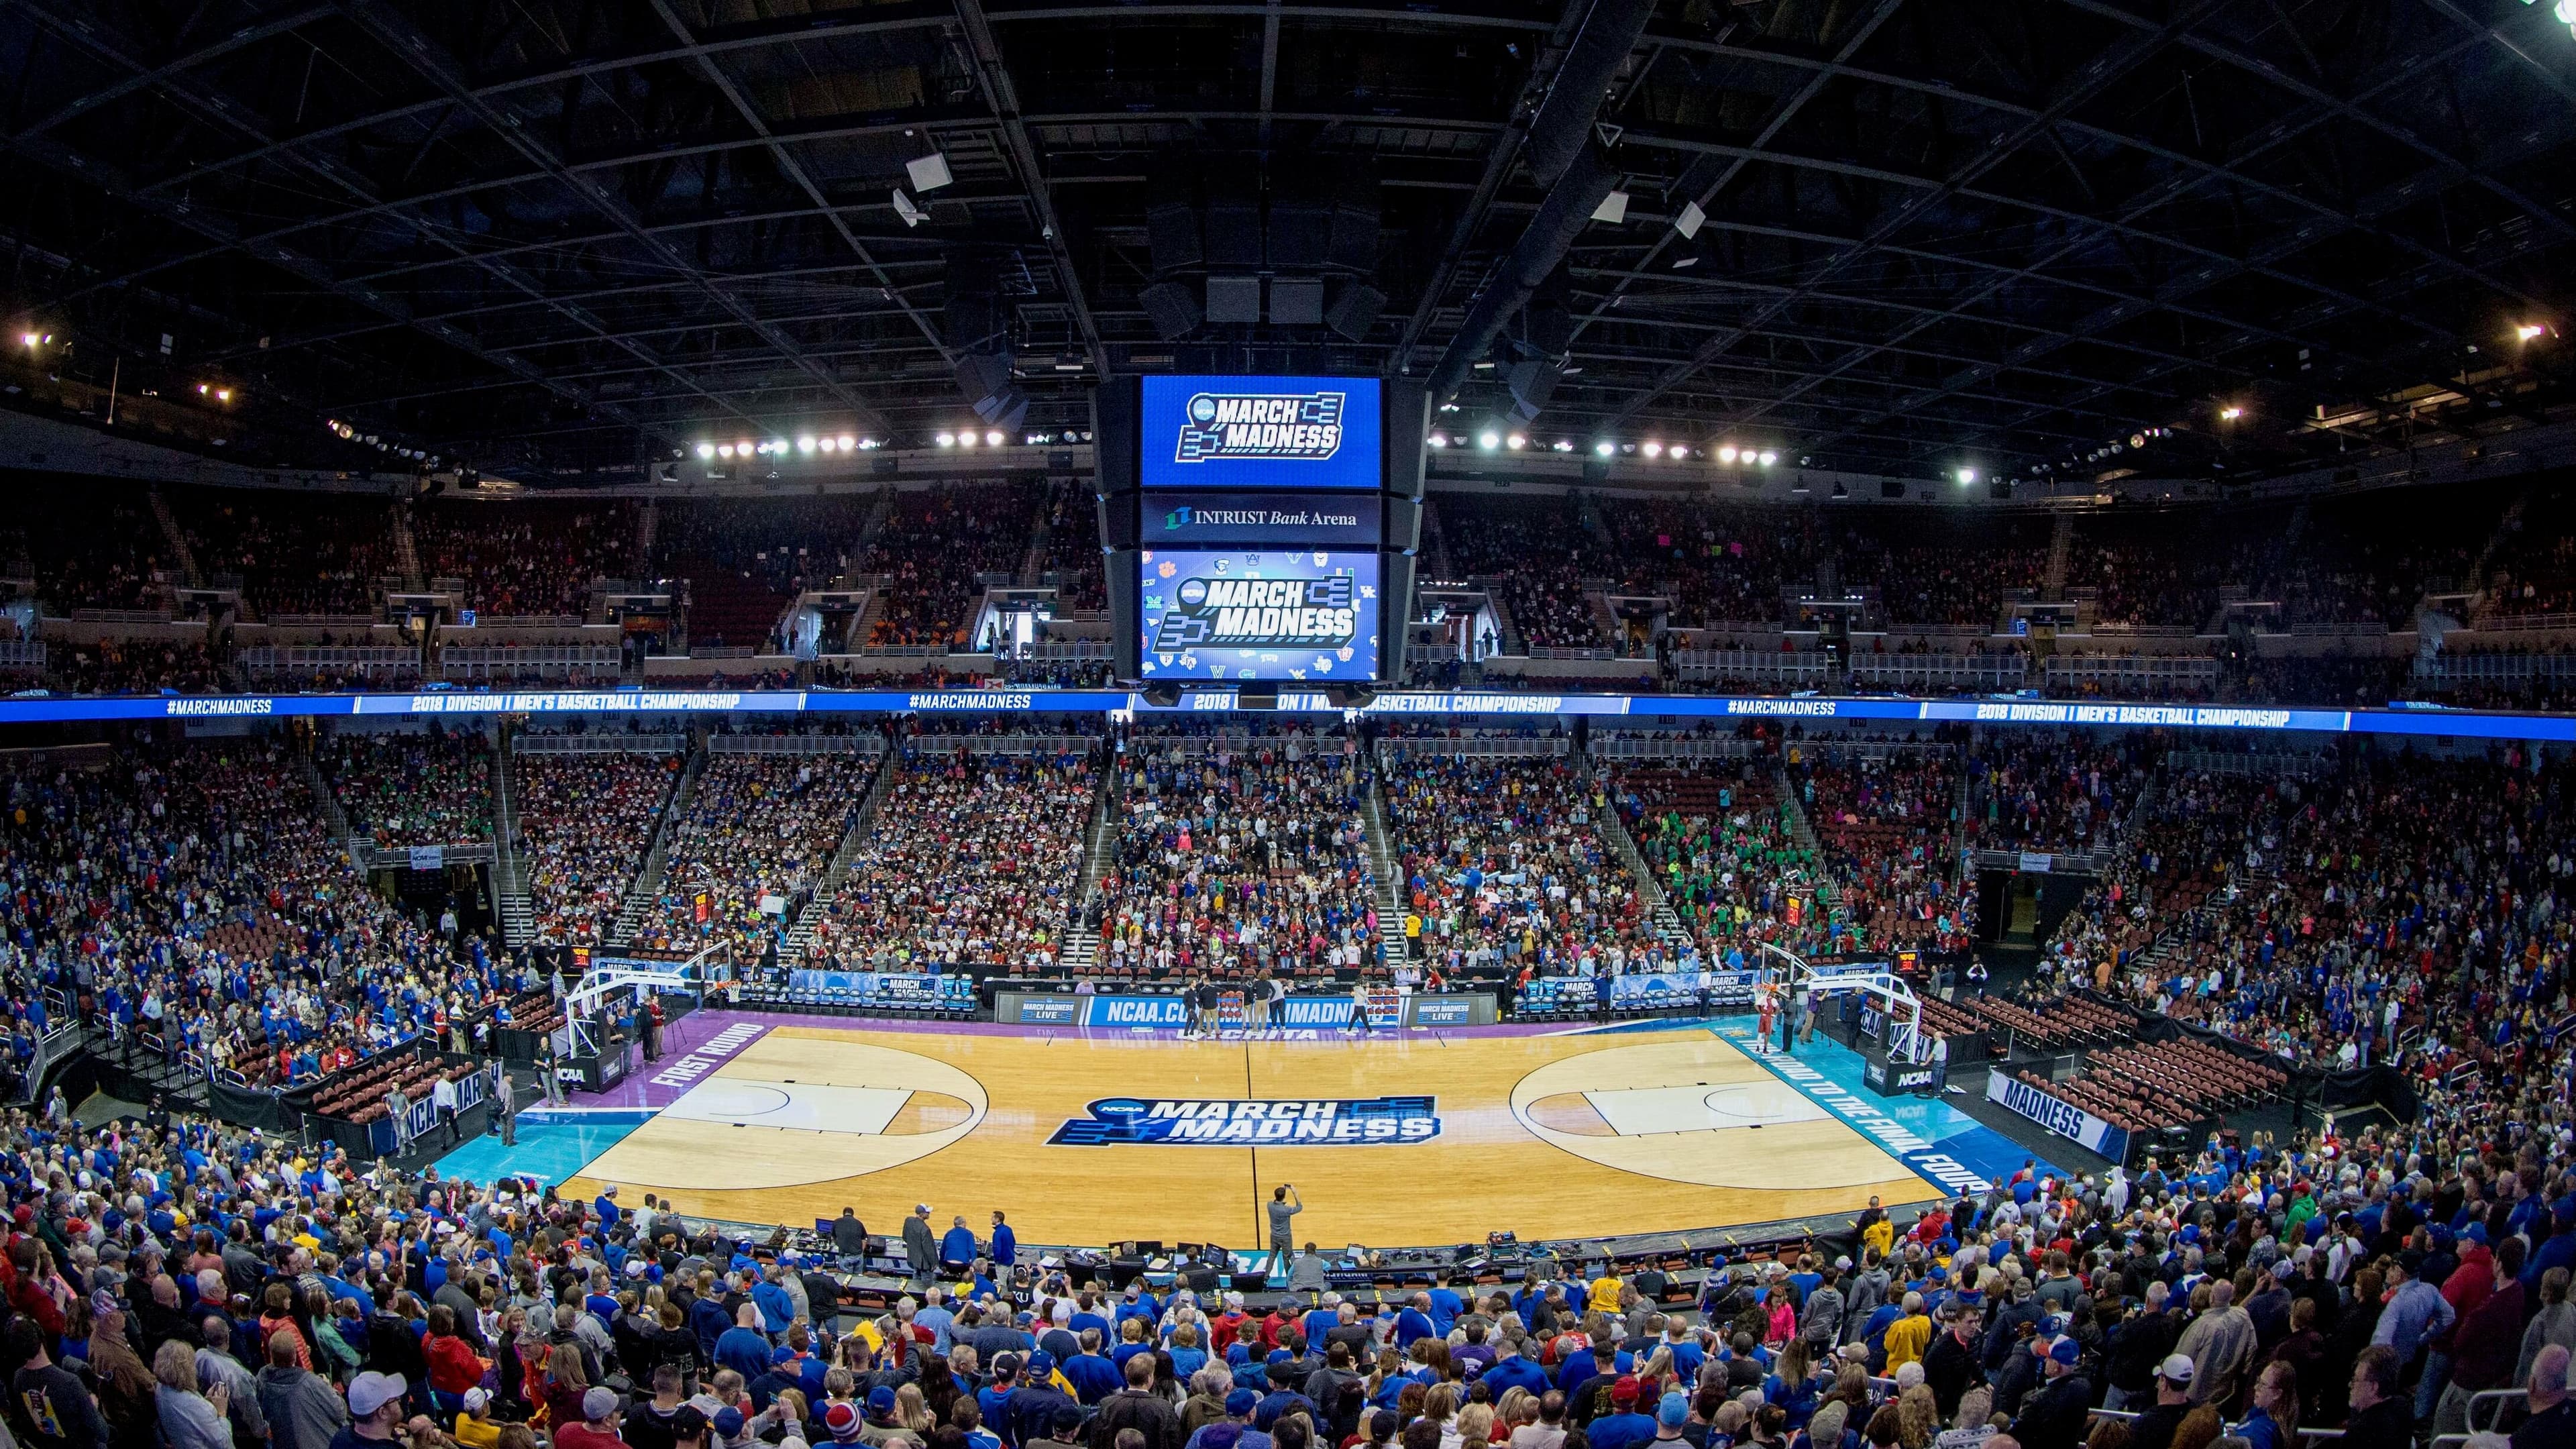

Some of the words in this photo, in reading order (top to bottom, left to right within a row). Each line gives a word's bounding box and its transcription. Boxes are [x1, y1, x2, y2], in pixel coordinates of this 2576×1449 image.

[1216, 400, 1299, 423] MARCH
[1226, 425, 1338, 449] MADNESS
[1195, 511, 1267, 524] INTRUST
[1269, 511, 1308, 525] Bank
[1311, 512, 1356, 525] Arena
[1205, 581, 1304, 607] MARCH
[1214, 608, 1353, 637] MADNESS
[166, 698, 272, 715] #MARCHMADNESS
[412, 696, 441, 711] 2018
[445, 695, 502, 711] DIVISION
[504, 695, 511, 710] I
[513, 695, 554, 710] MEN'S
[557, 694, 637, 710] BASKETBALL
[641, 693, 740, 710] CHAMPIONSHIP
[910, 694, 1031, 709] #MARCHMADNESS
[1194, 694, 1232, 710] 2018
[1452, 695, 1562, 712] CHAMPIONSHIP
[1727, 700, 1835, 715] #MARCHMADNESS
[1976, 704, 2008, 719] 2018
[2010, 704, 2065, 720] DIVISION
[2068, 706, 2075, 721] I
[2076, 706, 2117, 722] MEN'S
[2120, 707, 2194, 724] BASKETBALL
[2197, 709, 2290, 727] CHAMPIONSHIP
[576, 956, 586, 965] 30
[1902, 961, 1912, 970] 30
[890, 979, 920, 989] MARCH
[1564, 982, 1595, 993] MARCH
[1712, 976, 1739, 985] MARCH
[1036, 1011, 1058, 1019] LIVE
[649, 1054, 718, 1088] FIRST
[696, 1023, 765, 1057] ROUND
[1762, 1055, 1825, 1081] ROAD
[1801, 1081, 1847, 1095] TO
[1898, 1071, 1932, 1087] NCAA
[1148, 1102, 1339, 1119] MARCH
[1823, 1095, 1883, 1118] THE
[2004, 1079, 2084, 1139] MADNESS
[1167, 1118, 1433, 1138] MADNESS
[1856, 1118, 1935, 1154] FINAL
[1908, 1153, 1994, 1193] FOUR
